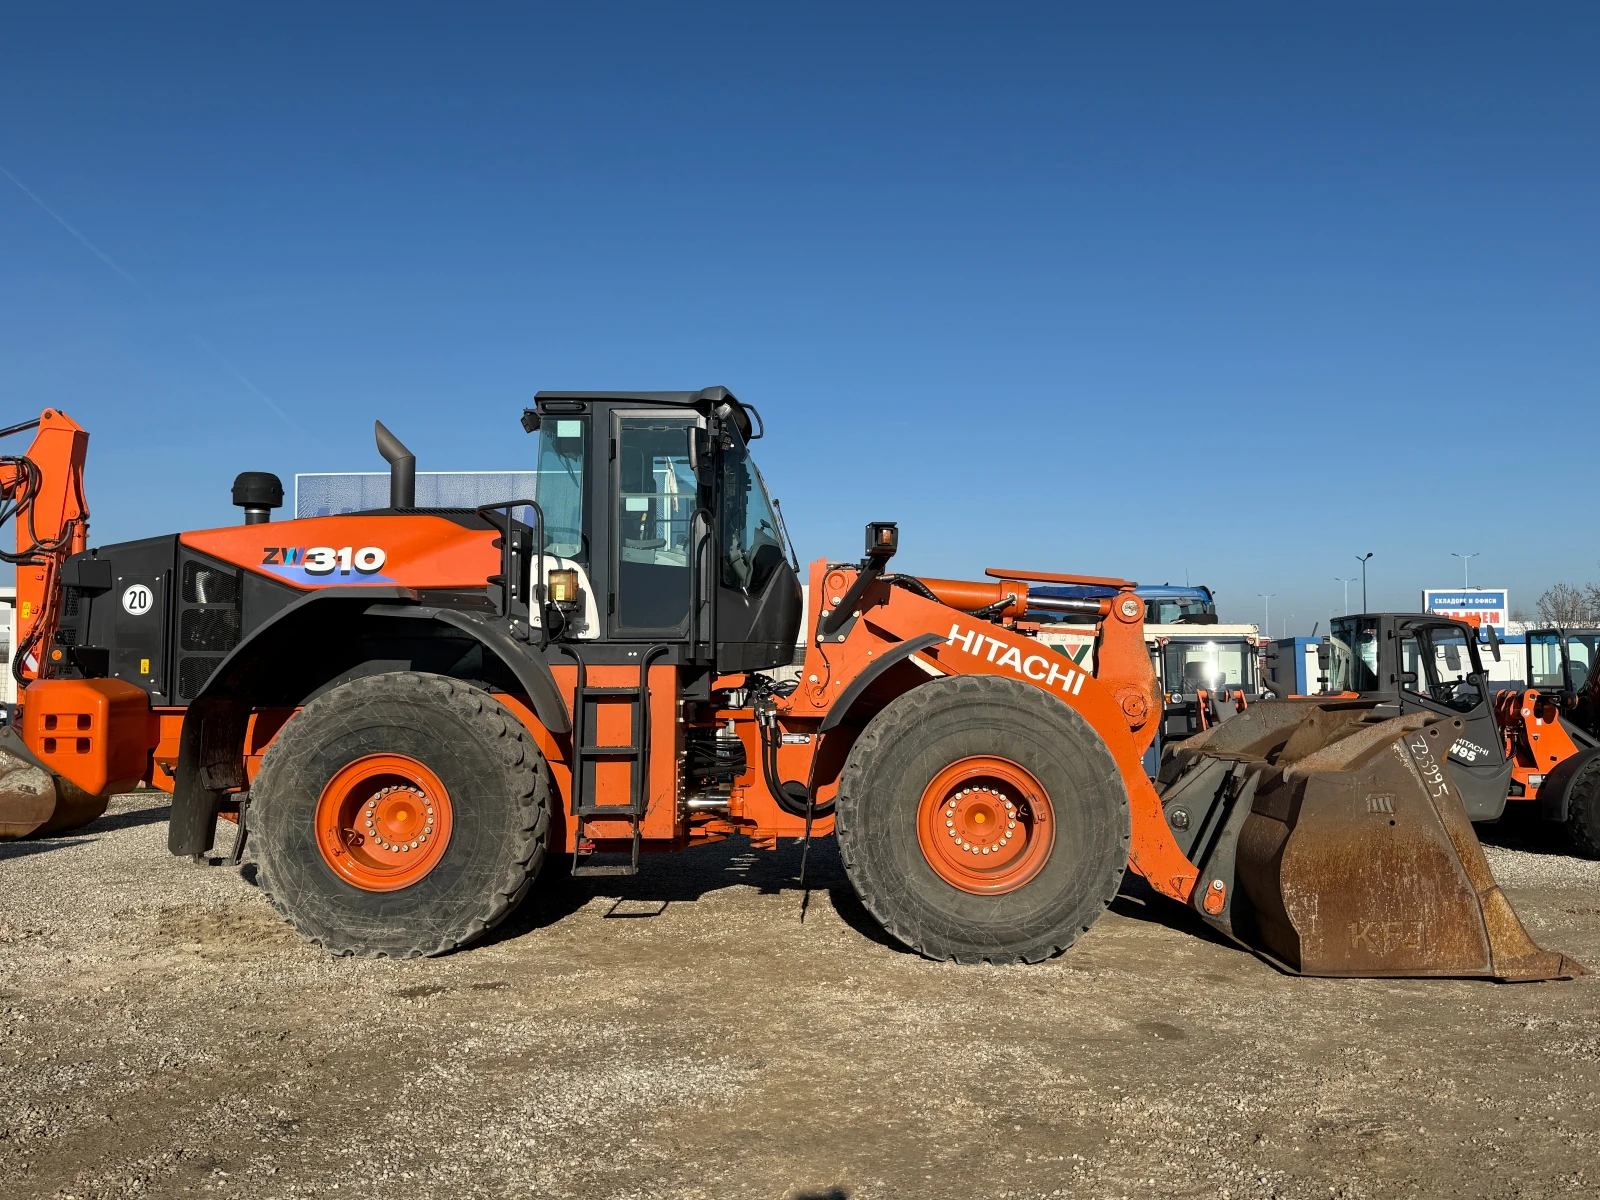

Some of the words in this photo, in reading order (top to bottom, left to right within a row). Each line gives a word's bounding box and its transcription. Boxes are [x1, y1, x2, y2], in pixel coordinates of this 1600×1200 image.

[262, 546, 386, 576] ZW310
[129, 591, 147, 609] 20
[945, 623, 1086, 696] HITACHI
[1455, 738, 1489, 756] HITACHI
